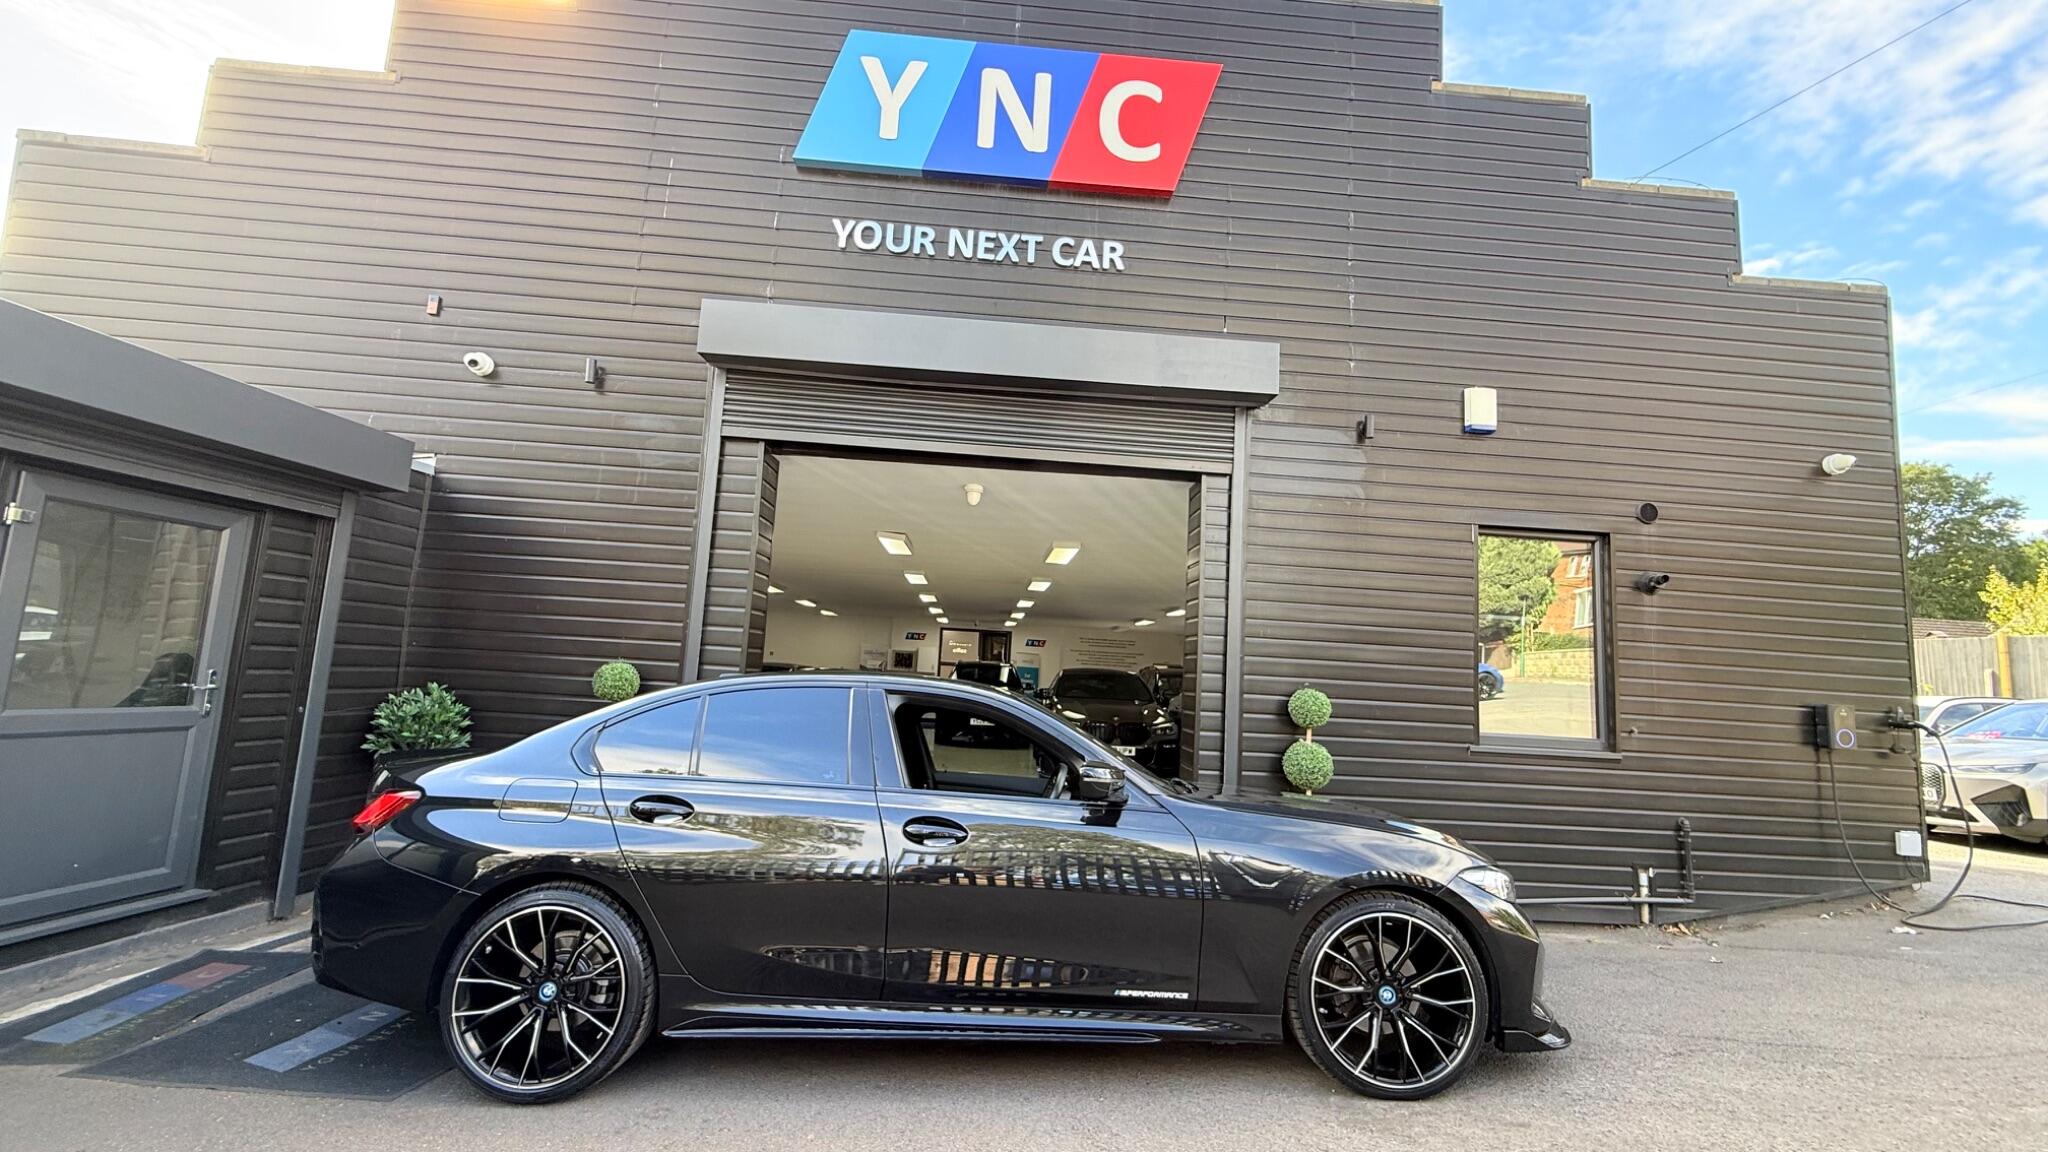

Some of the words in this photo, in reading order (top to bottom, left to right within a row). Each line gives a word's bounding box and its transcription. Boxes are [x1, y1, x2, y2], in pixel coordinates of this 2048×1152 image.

[860, 55, 1163, 163] YNC
[832, 218, 936, 257] YOUR
[948, 227, 1043, 264] NEXT
[1052, 236, 1126, 271] CAR
